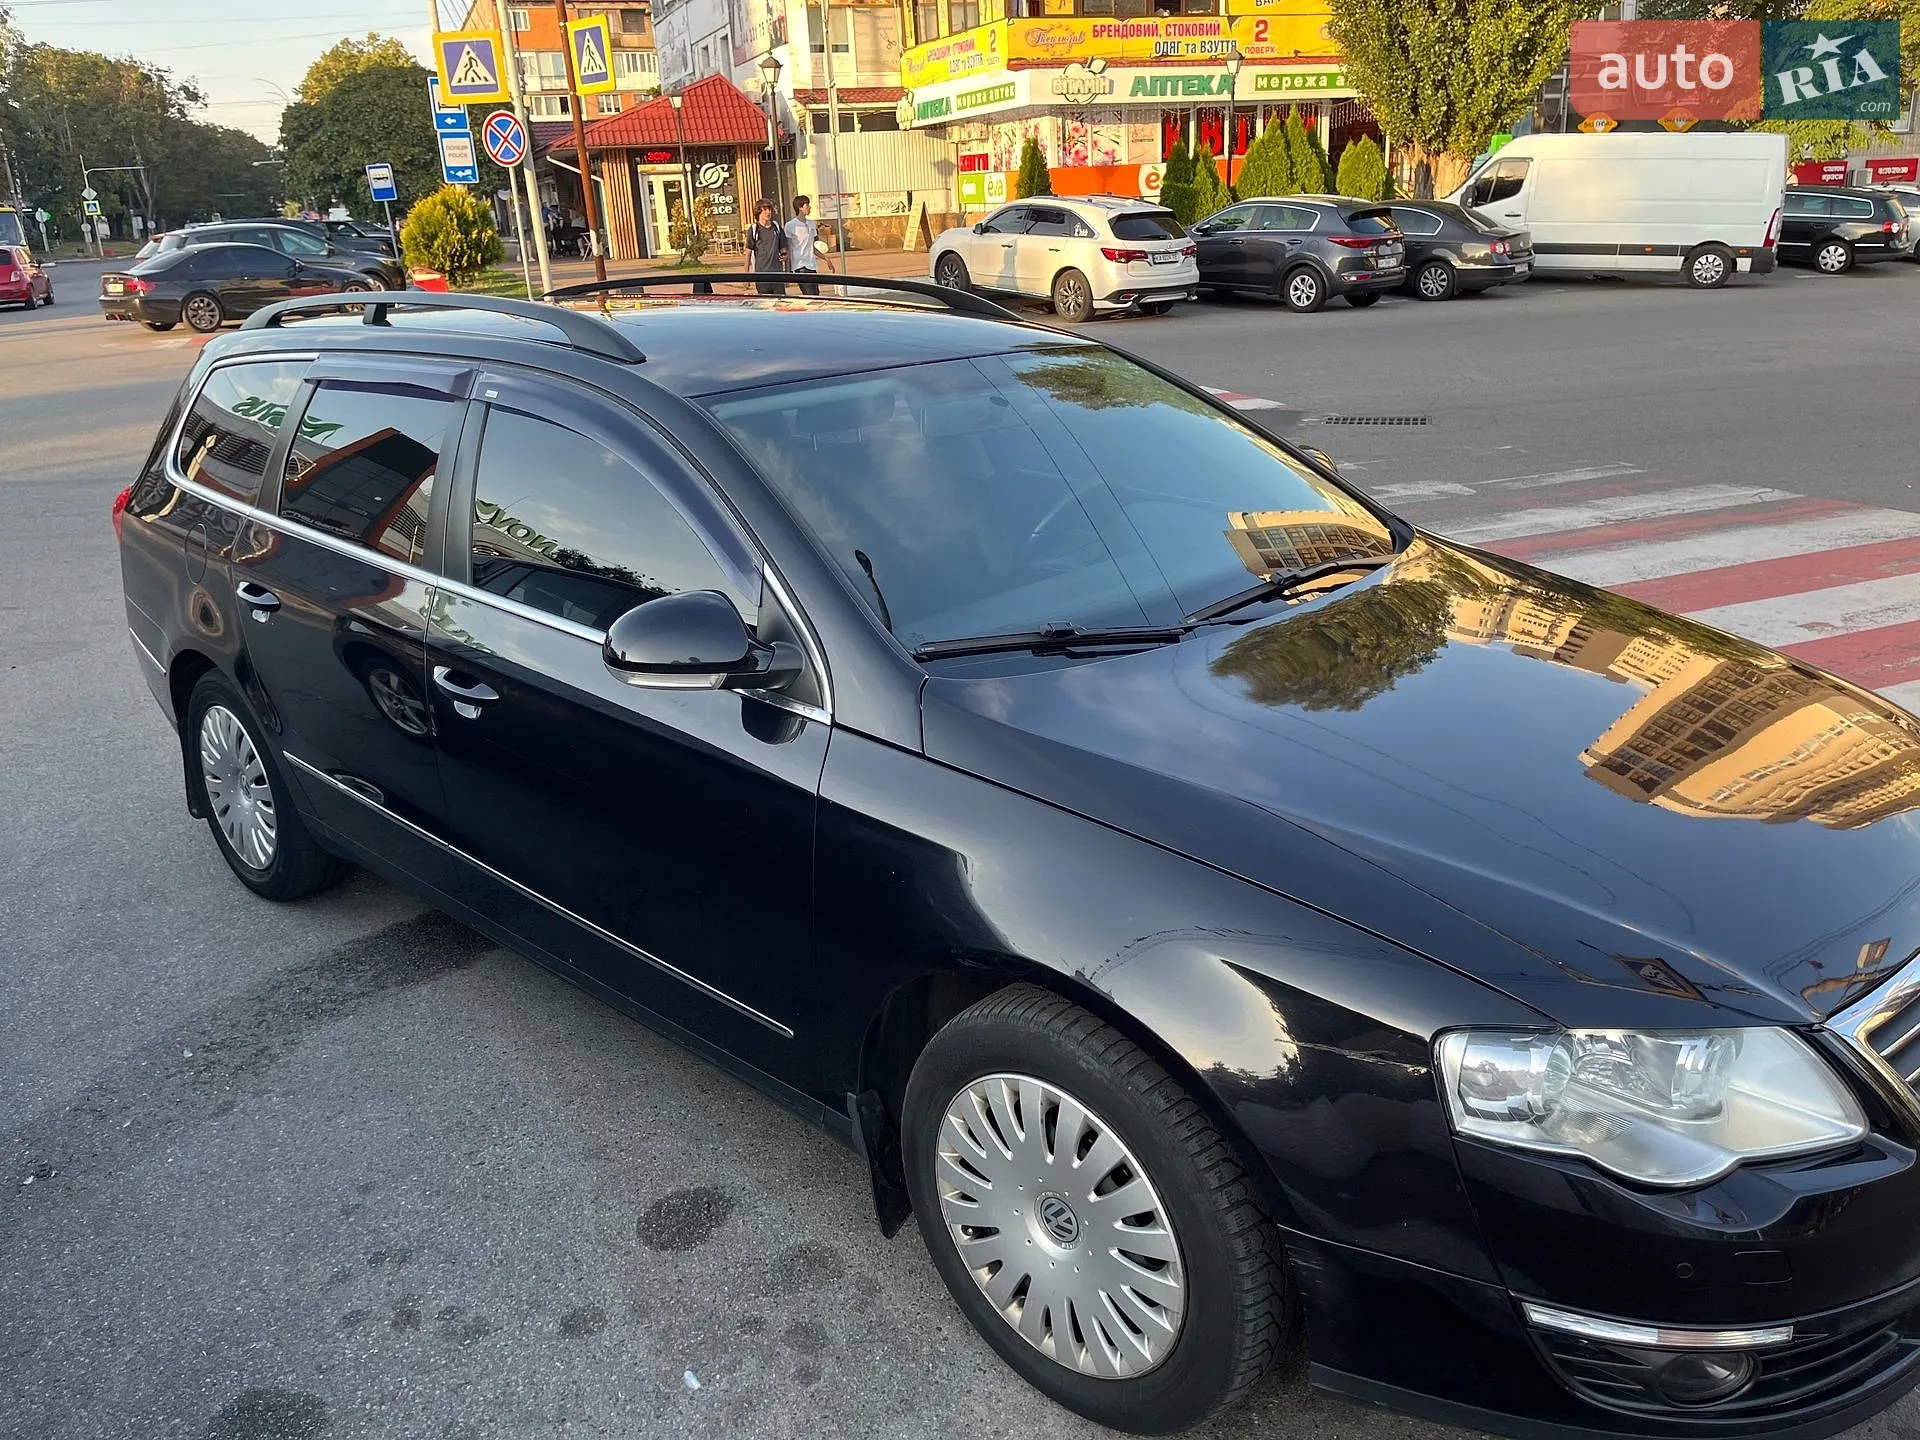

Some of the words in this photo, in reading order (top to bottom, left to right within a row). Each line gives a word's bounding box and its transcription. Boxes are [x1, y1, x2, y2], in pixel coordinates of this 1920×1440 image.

[1092, 22, 1162, 39] БРЕНДОВИЙ,
[1165, 21, 1221, 37] СТОКОВИЙ
[1254, 19, 1269, 42] 2
[989, 28, 997, 53] 2
[1154, 40, 1182, 55] ОДЯГ
[1185, 43, 1196, 54] та
[1200, 40, 1237, 54] ВЗУТТЯ
[1244, 46, 1276, 55] ПОВЕРХ
[1129, 75, 1234, 97] АПТЕКА
[1256, 75, 1328, 91] мережа
[987, 175, 1004, 197] èva
[709, 193, 734, 204] ffee
[704, 205, 733, 216] pace
